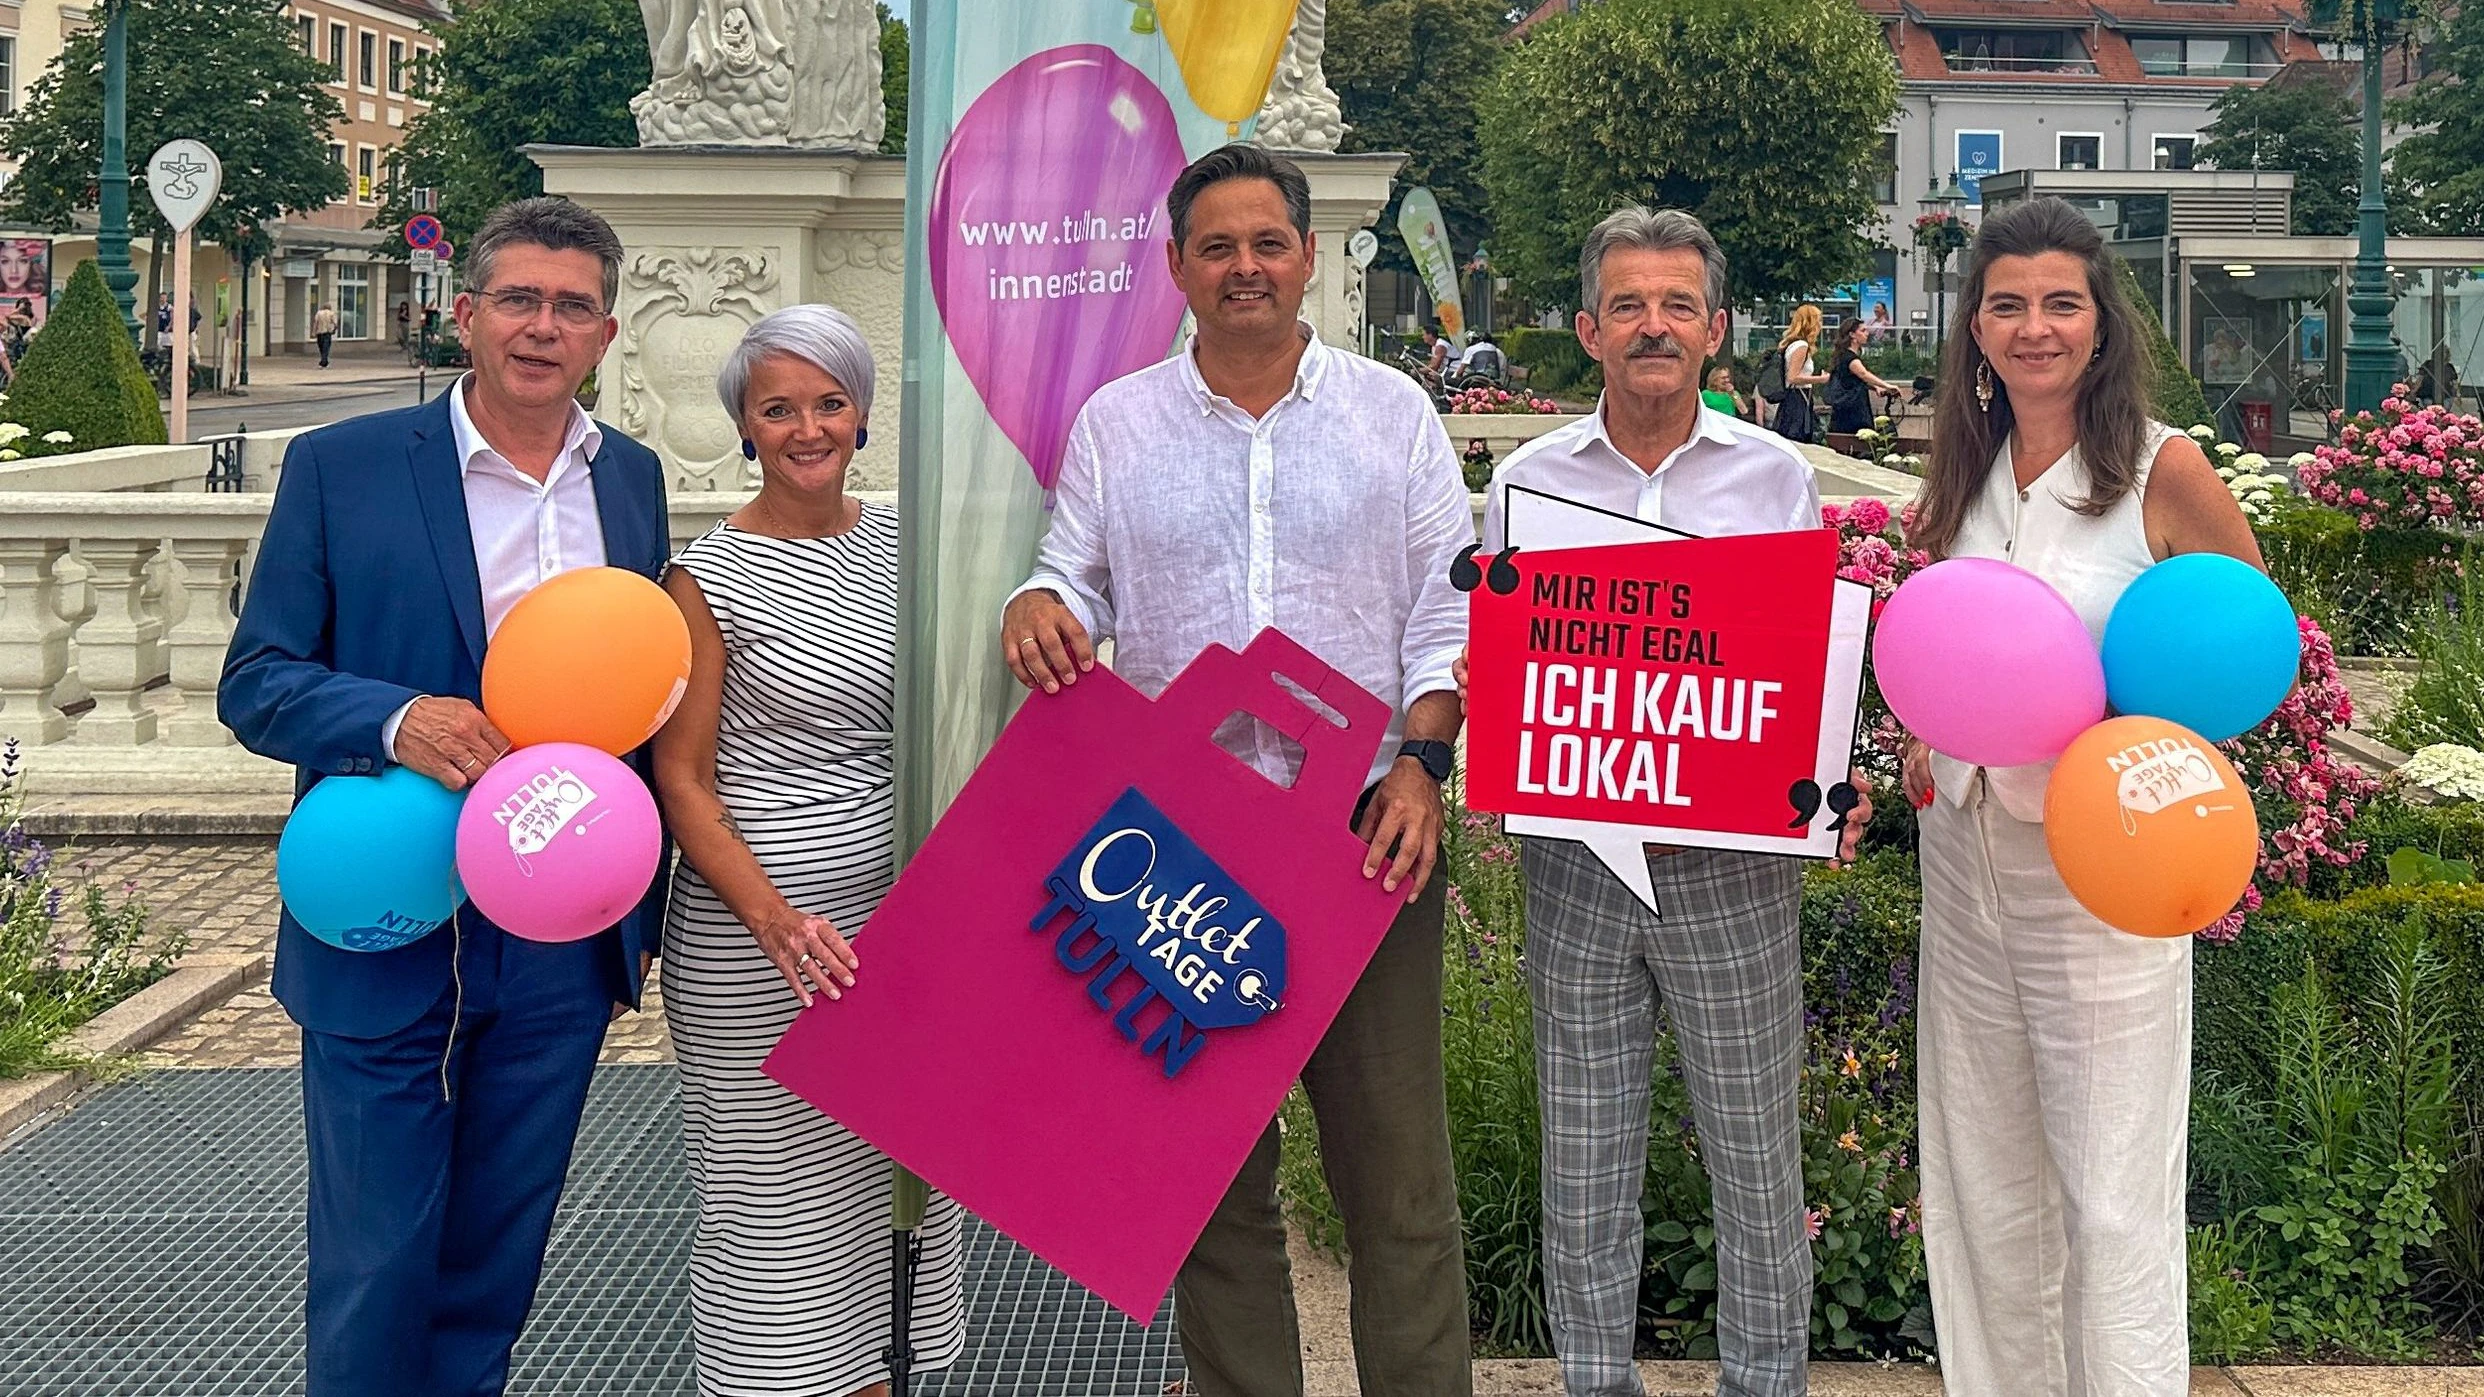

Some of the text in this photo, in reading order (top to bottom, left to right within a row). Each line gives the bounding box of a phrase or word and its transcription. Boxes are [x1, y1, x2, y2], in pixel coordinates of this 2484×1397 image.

[961, 207, 1157, 246] www.tulln.at/
[989, 261, 1133, 300] innenstadt
[1532, 571, 1692, 619] MIR IST'S
[1528, 617, 1725, 667] NICHT EGAL
[1522, 661, 1783, 744] ICH KAUF
[492, 765, 566, 827] TULLN
[1516, 730, 1692, 807] LOKAL
[529, 779, 584, 842] Outlet
[376, 909, 439, 934] ULLN
[1078, 827, 1263, 966] Outlet
[1028, 876, 1207, 1079] TULLN
[1136, 914, 1225, 1004] TAGE
